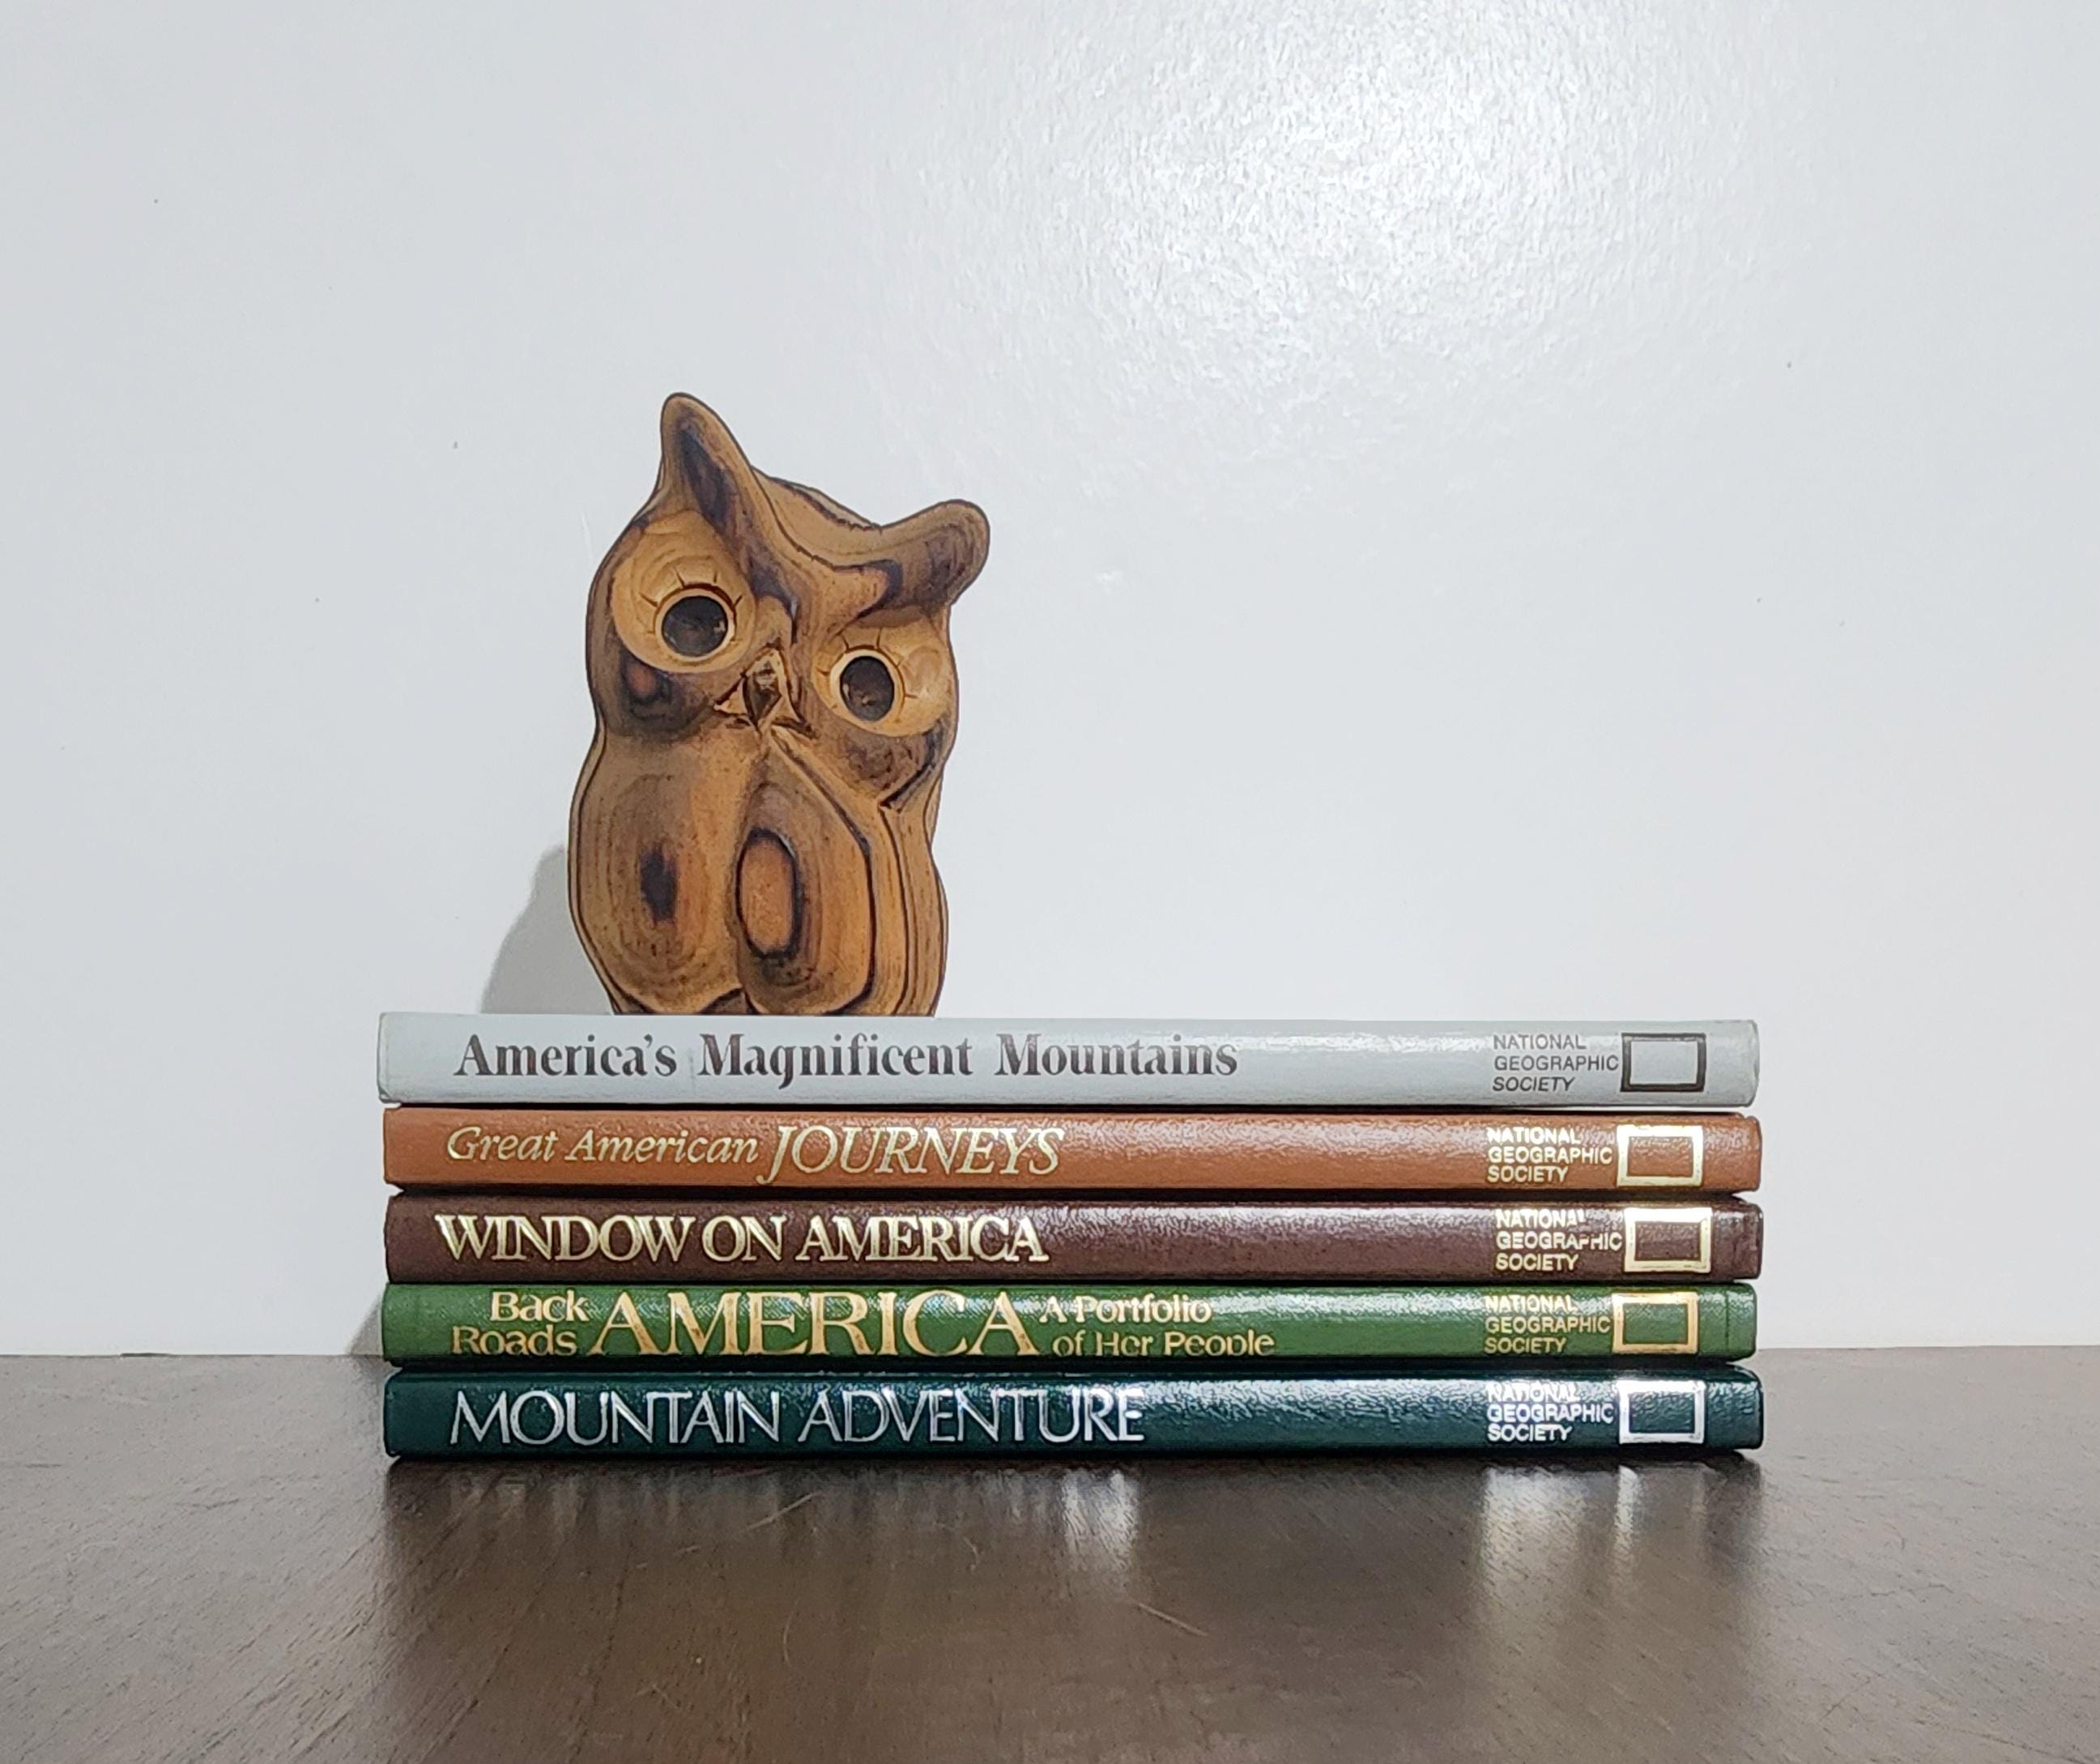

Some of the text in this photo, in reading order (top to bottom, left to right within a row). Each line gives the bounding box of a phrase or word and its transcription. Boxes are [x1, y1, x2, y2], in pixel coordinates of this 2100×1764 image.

[1493, 1033, 1587, 1050] NATIONAL
[454, 1033, 1237, 1089] America's Magnificent Mountains
[1494, 1055, 1619, 1071] GEOGRAPHIC
[1492, 1076, 1574, 1092] SOCIETY
[1486, 1127, 1582, 1145] NATIONAL
[446, 1125, 1065, 1185] Great American JOURNEYS
[1487, 1146, 1612, 1165] GEOGRAPHIC
[1487, 1166, 1569, 1182] SOCIETY
[435, 1215, 1049, 1262] WINDOW ON AMERICA
[1495, 1254, 1579, 1271] SOCIETY
[489, 1291, 590, 1323] Back
[1039, 1294, 1212, 1323] A Portfolio
[1484, 1295, 1577, 1313] NATIONAL
[586, 1289, 1040, 1357] AMERICA
[1484, 1317, 1612, 1334] GEOGRAPHIC
[452, 1324, 578, 1357] Roads
[1053, 1329, 1082, 1357] of
[1095, 1332, 1154, 1357] Her
[1484, 1338, 1567, 1354] SOCIETY
[1486, 1383, 1582, 1403] NATIONAL
[450, 1387, 1145, 1446] MOUNTAIN ADVENTURE
[1487, 1404, 1615, 1422] GEOGRAPHIC
[1487, 1425, 1572, 1442] SOCIETY
